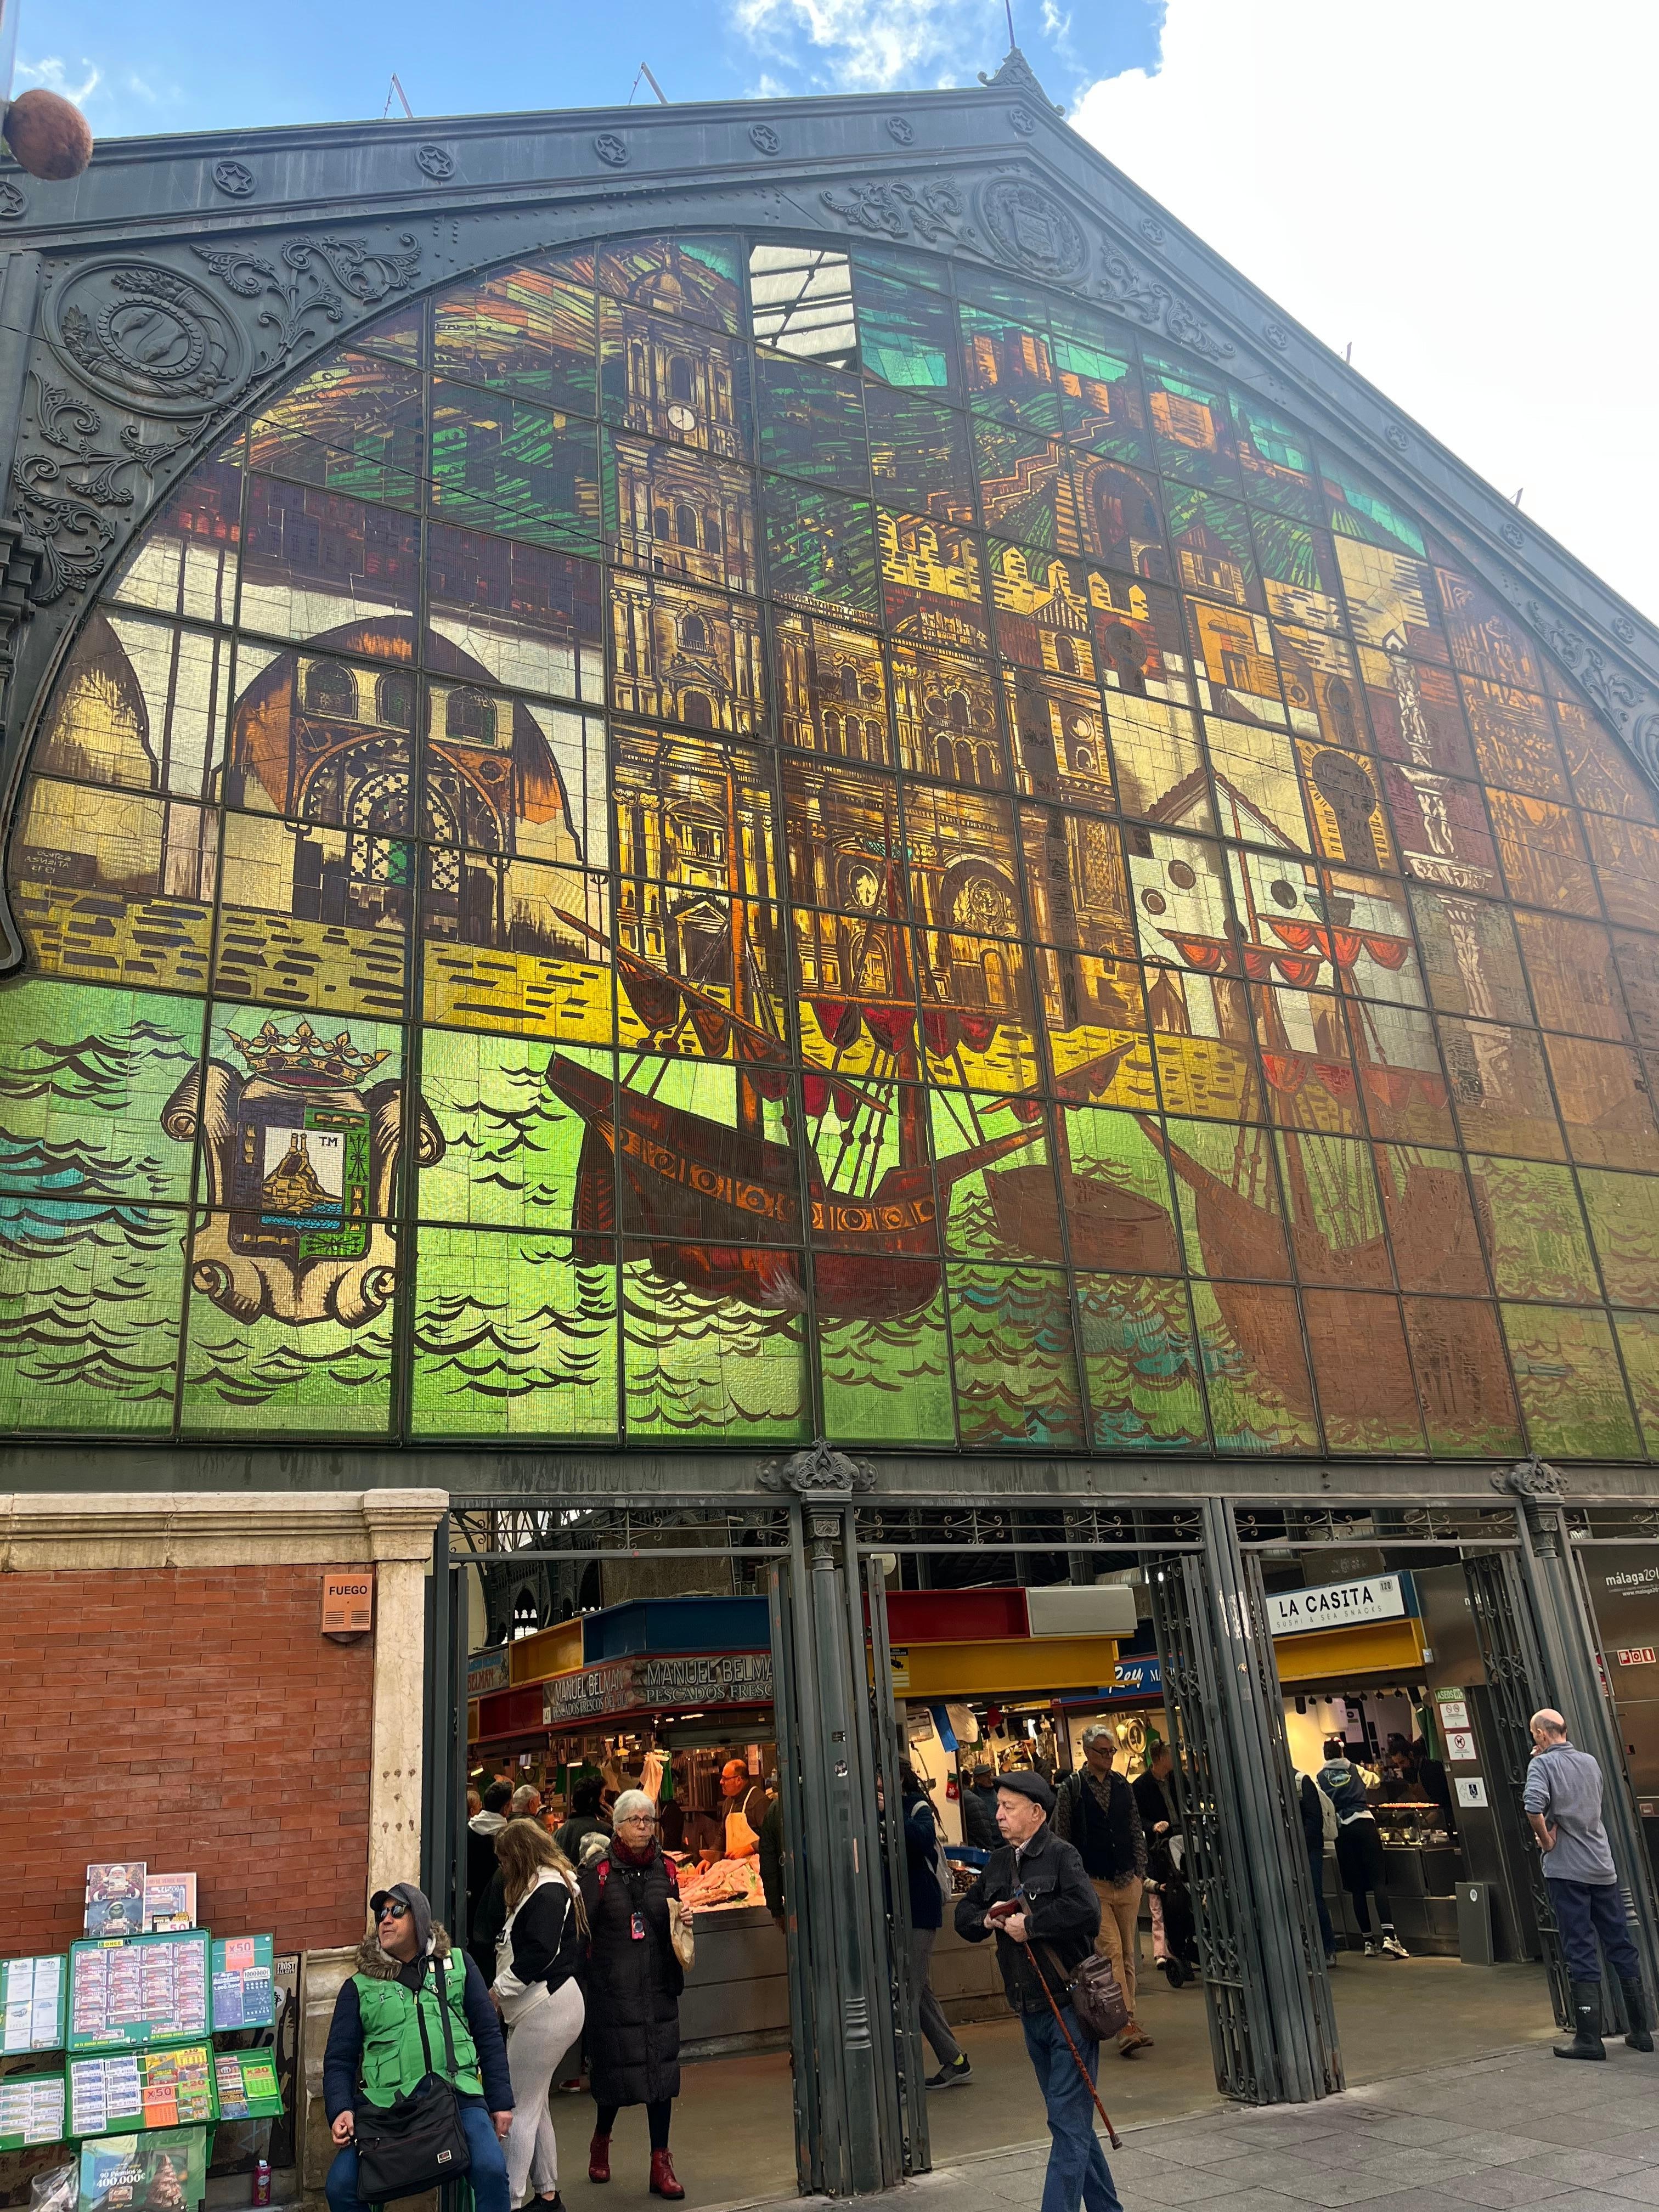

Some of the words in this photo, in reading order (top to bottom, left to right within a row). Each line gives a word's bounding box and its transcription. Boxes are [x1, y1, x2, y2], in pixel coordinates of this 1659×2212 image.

[329, 1585, 368, 1595] FUEGO
[1380, 1582, 1391, 1590] 120
[1279, 1599, 1300, 1618] LA
[1306, 1586, 1374, 1613] CASITA
[1277, 1620, 1304, 1628] SUSHI
[1321, 1613, 1338, 1621] SEA
[1345, 1605, 1383, 1617] SNACKS
[647, 1660, 717, 1686] MANUEL
[555, 1677, 586, 1702] MANUEL
[589, 1668, 624, 1696] BELMAN
[646, 1684, 725, 1703] PESCADOS
[552, 1702, 580, 1719] PESCADOS
[579, 1697, 603, 1714] FRESCOS
[605, 1695, 616, 1708] DEL
[229, 1942, 251, 1953] x50
[277, 1961, 295, 1971] FROST
[147, 2087, 172, 2098] x50
[96, 2172, 146, 2188] 400.000€
